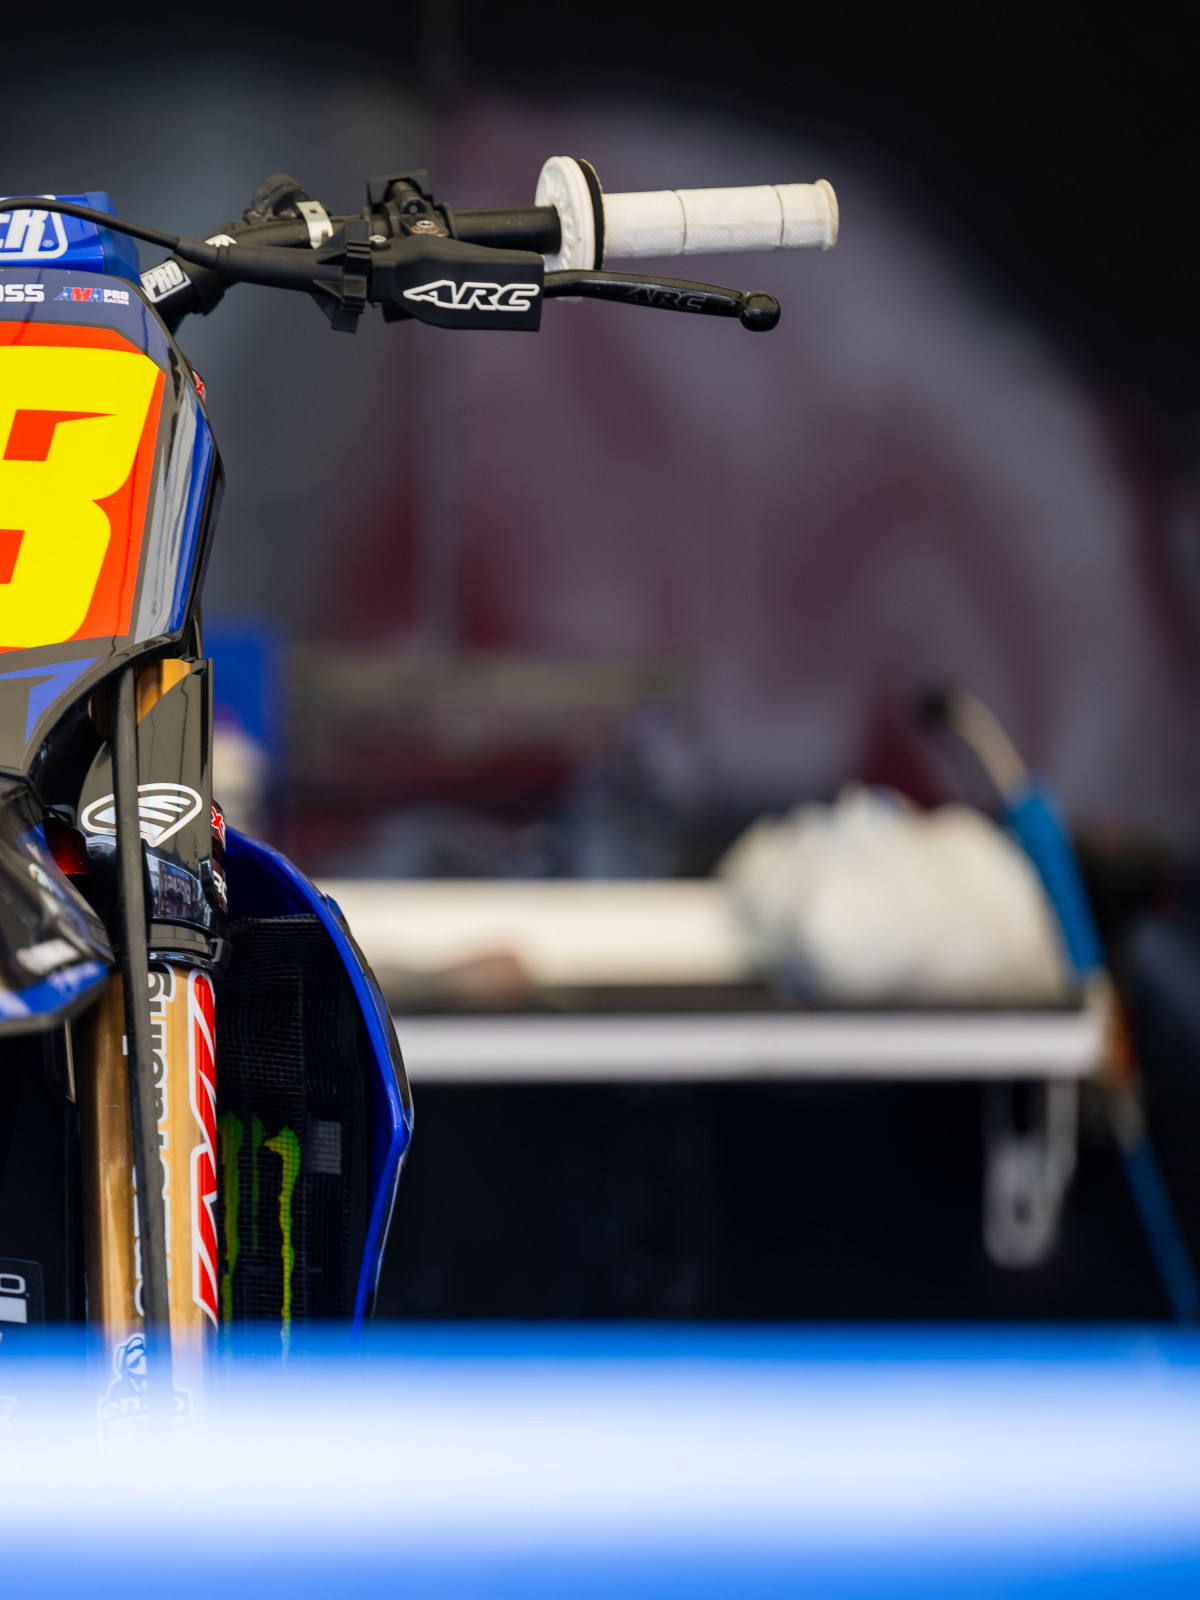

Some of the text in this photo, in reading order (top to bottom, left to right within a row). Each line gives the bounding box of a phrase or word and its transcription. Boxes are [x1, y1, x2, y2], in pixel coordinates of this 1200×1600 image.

[54, 287, 103, 302] AMA
[103, 288, 130, 300] PRO
[403, 279, 540, 312] ARC
